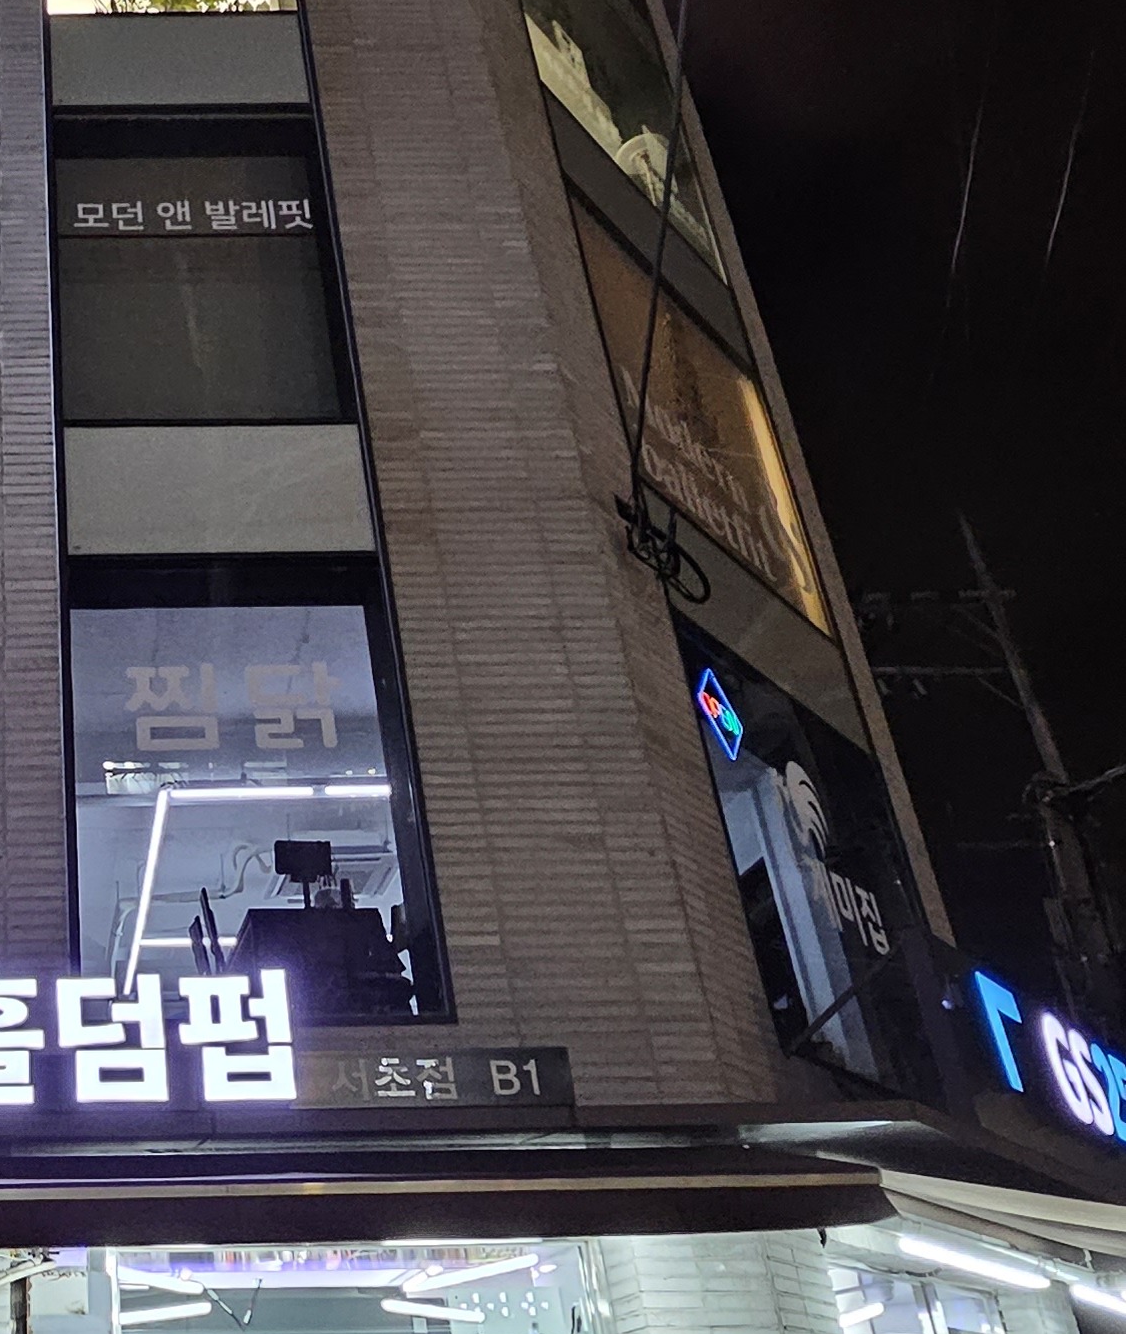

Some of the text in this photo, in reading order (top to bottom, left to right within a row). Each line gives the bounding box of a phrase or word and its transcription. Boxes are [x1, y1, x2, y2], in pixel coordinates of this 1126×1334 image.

[74, 198, 314, 231] 모던 앤 발레핏
[491, 1058, 543, 1097] B1
